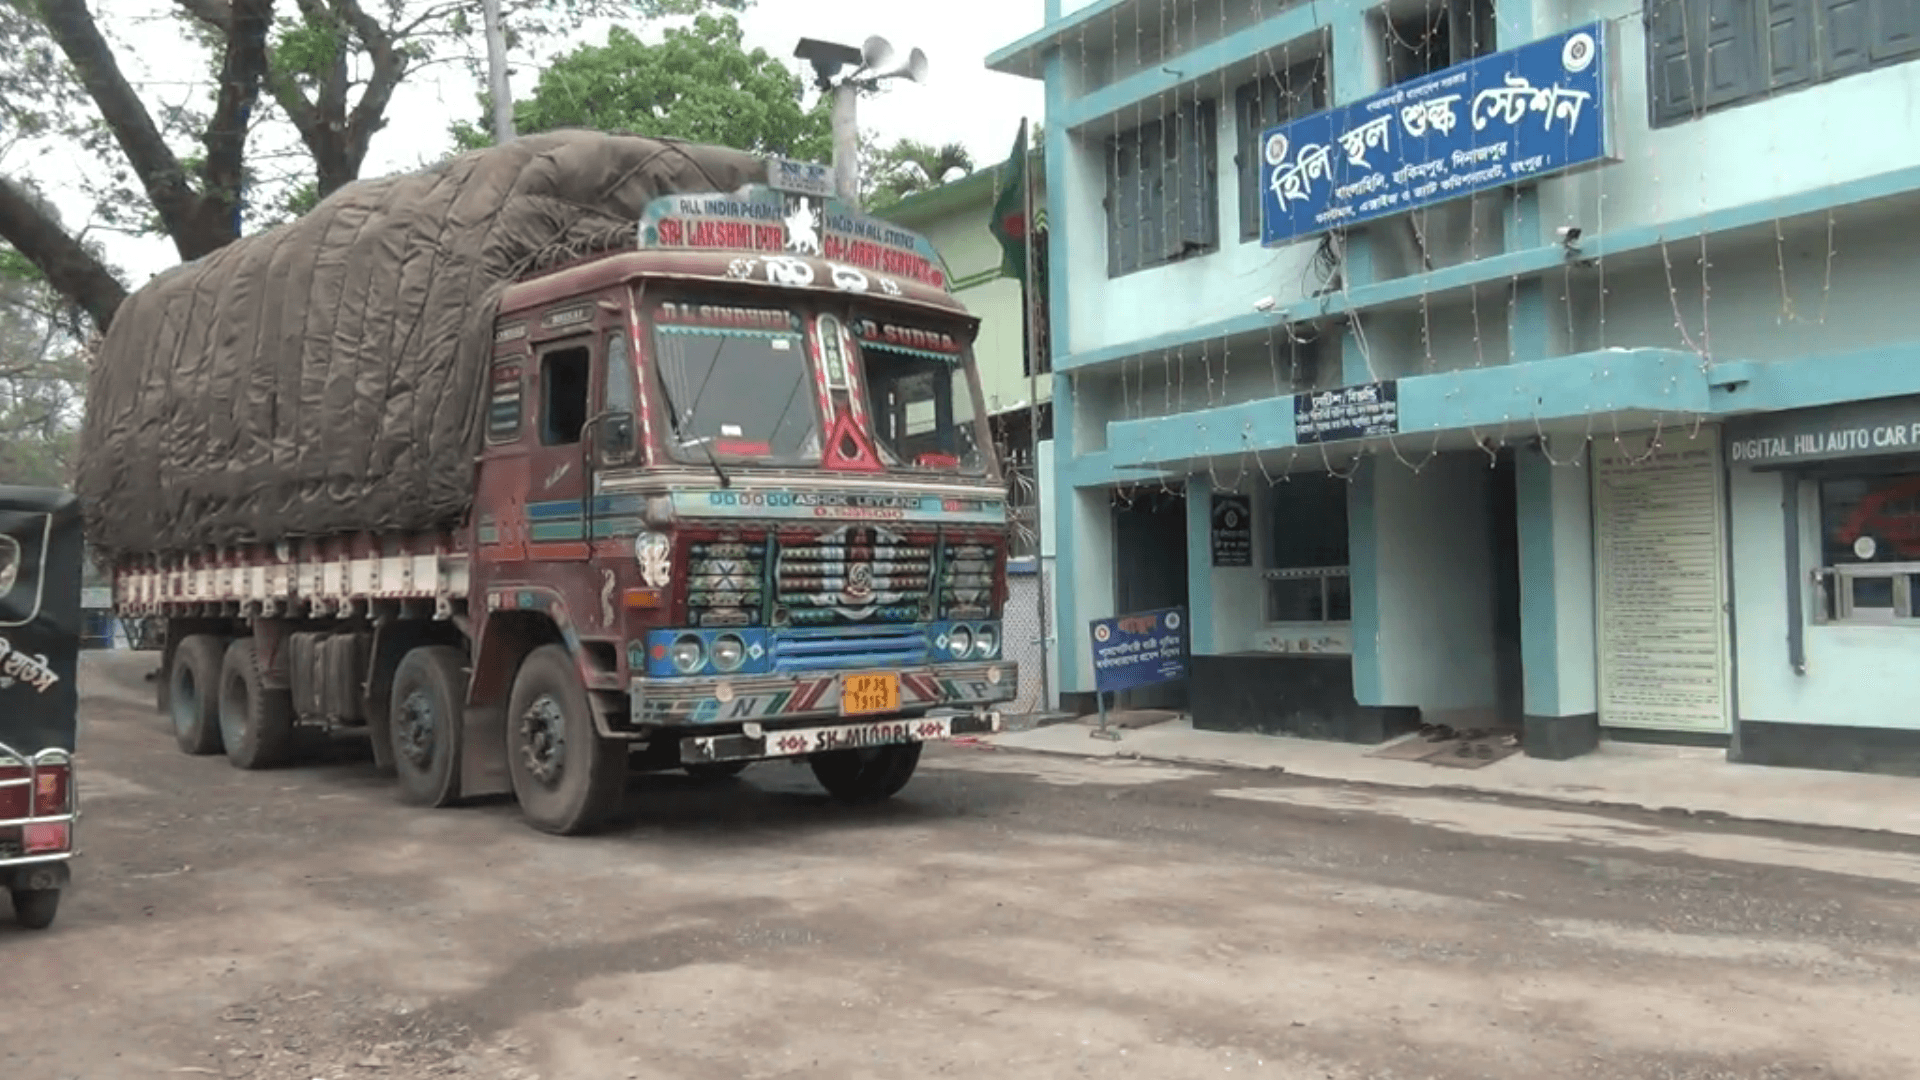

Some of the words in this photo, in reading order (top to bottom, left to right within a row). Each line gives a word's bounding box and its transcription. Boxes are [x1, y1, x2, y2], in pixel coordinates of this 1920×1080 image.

[1269, 143, 1332, 213] হিলি
[1337, 113, 1393, 170] স্থল
[1401, 94, 1462, 137] শুল্ক
[1471, 71, 1592, 136] স্টেশন
[1451, 141, 1509, 169] দিনাজপুর
[679, 198, 702, 215] ALL
[686, 219, 753, 249] LAKSHMI
[1731, 436, 1791, 461] DIGITAL
[1794, 433, 1824, 455] HILI
[1826, 429, 1869, 452] AUTO
[1873, 425, 1908, 447] CAR
[794, 494, 848, 507] ASHOK
[856, 495, 920, 509] LEYLAND
